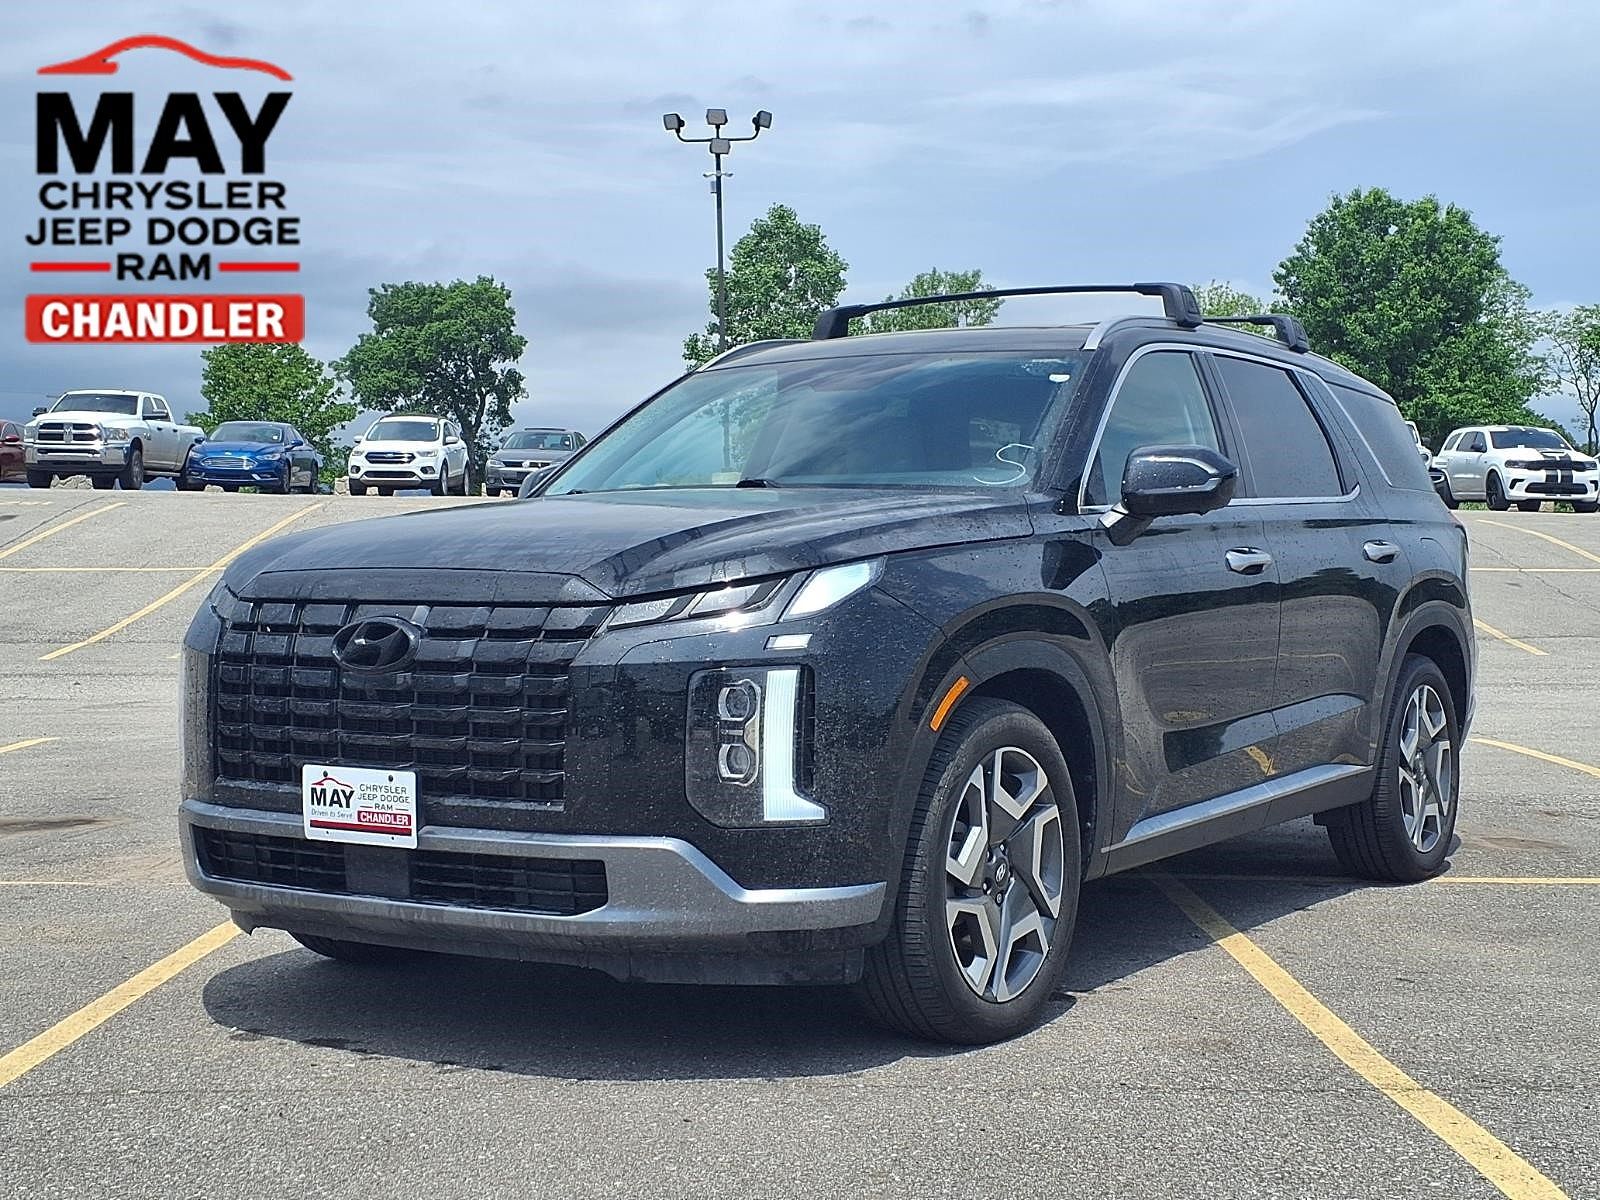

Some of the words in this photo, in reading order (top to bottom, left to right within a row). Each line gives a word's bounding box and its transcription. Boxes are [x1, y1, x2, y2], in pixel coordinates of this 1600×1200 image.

[359, 783, 407, 795] CHRYSLER
[311, 787, 355, 809] MAY
[358, 793, 378, 801] JEEP
[380, 794, 411, 804] DODGE
[374, 803, 394, 812] RAM
[311, 808, 329, 817] Driven
[337, 811, 353, 819] Serve
[360, 811, 409, 826] CHANDLER
